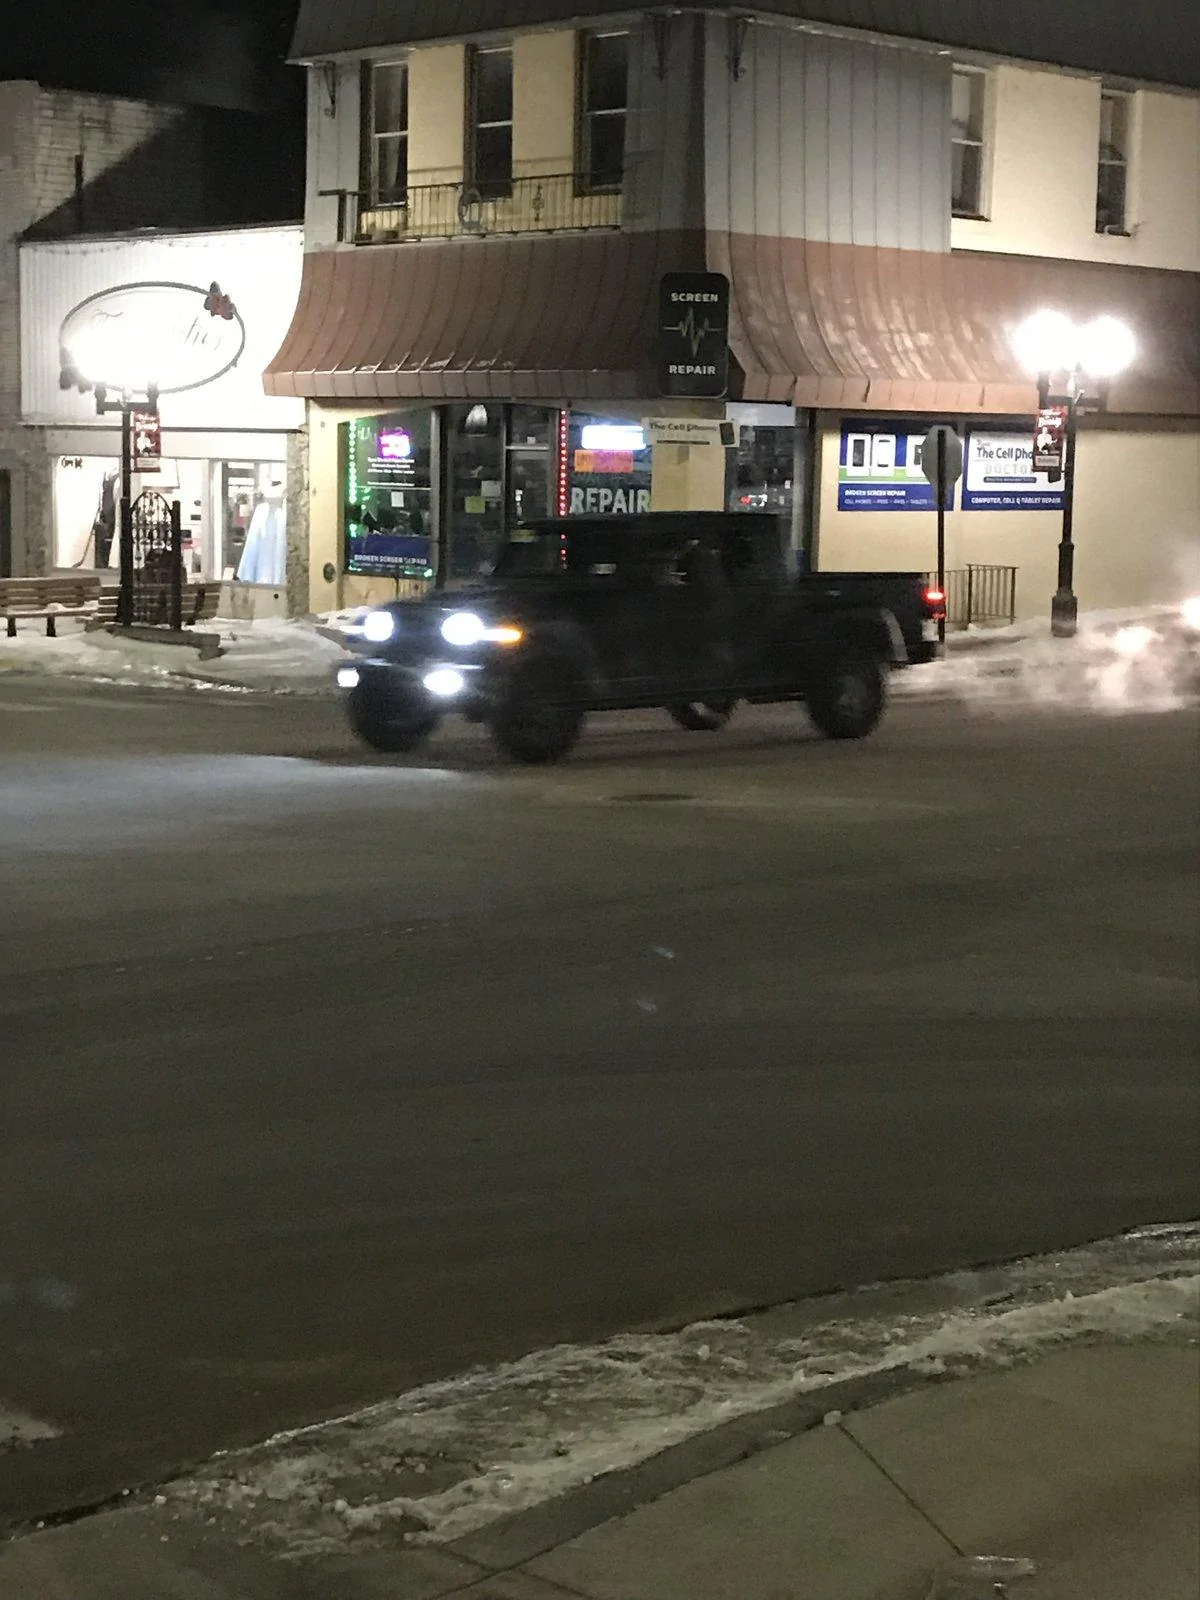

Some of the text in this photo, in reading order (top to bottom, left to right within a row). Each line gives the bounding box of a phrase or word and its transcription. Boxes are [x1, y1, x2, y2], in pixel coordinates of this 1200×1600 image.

[670, 292, 719, 302] SCREEN
[669, 364, 716, 375] REPAIR
[650, 421, 666, 430] The
[668, 422, 686, 431] Cell
[976, 447, 994, 459] The
[996, 448, 1014, 459] Cell
[569, 486, 651, 514] REPAIR
